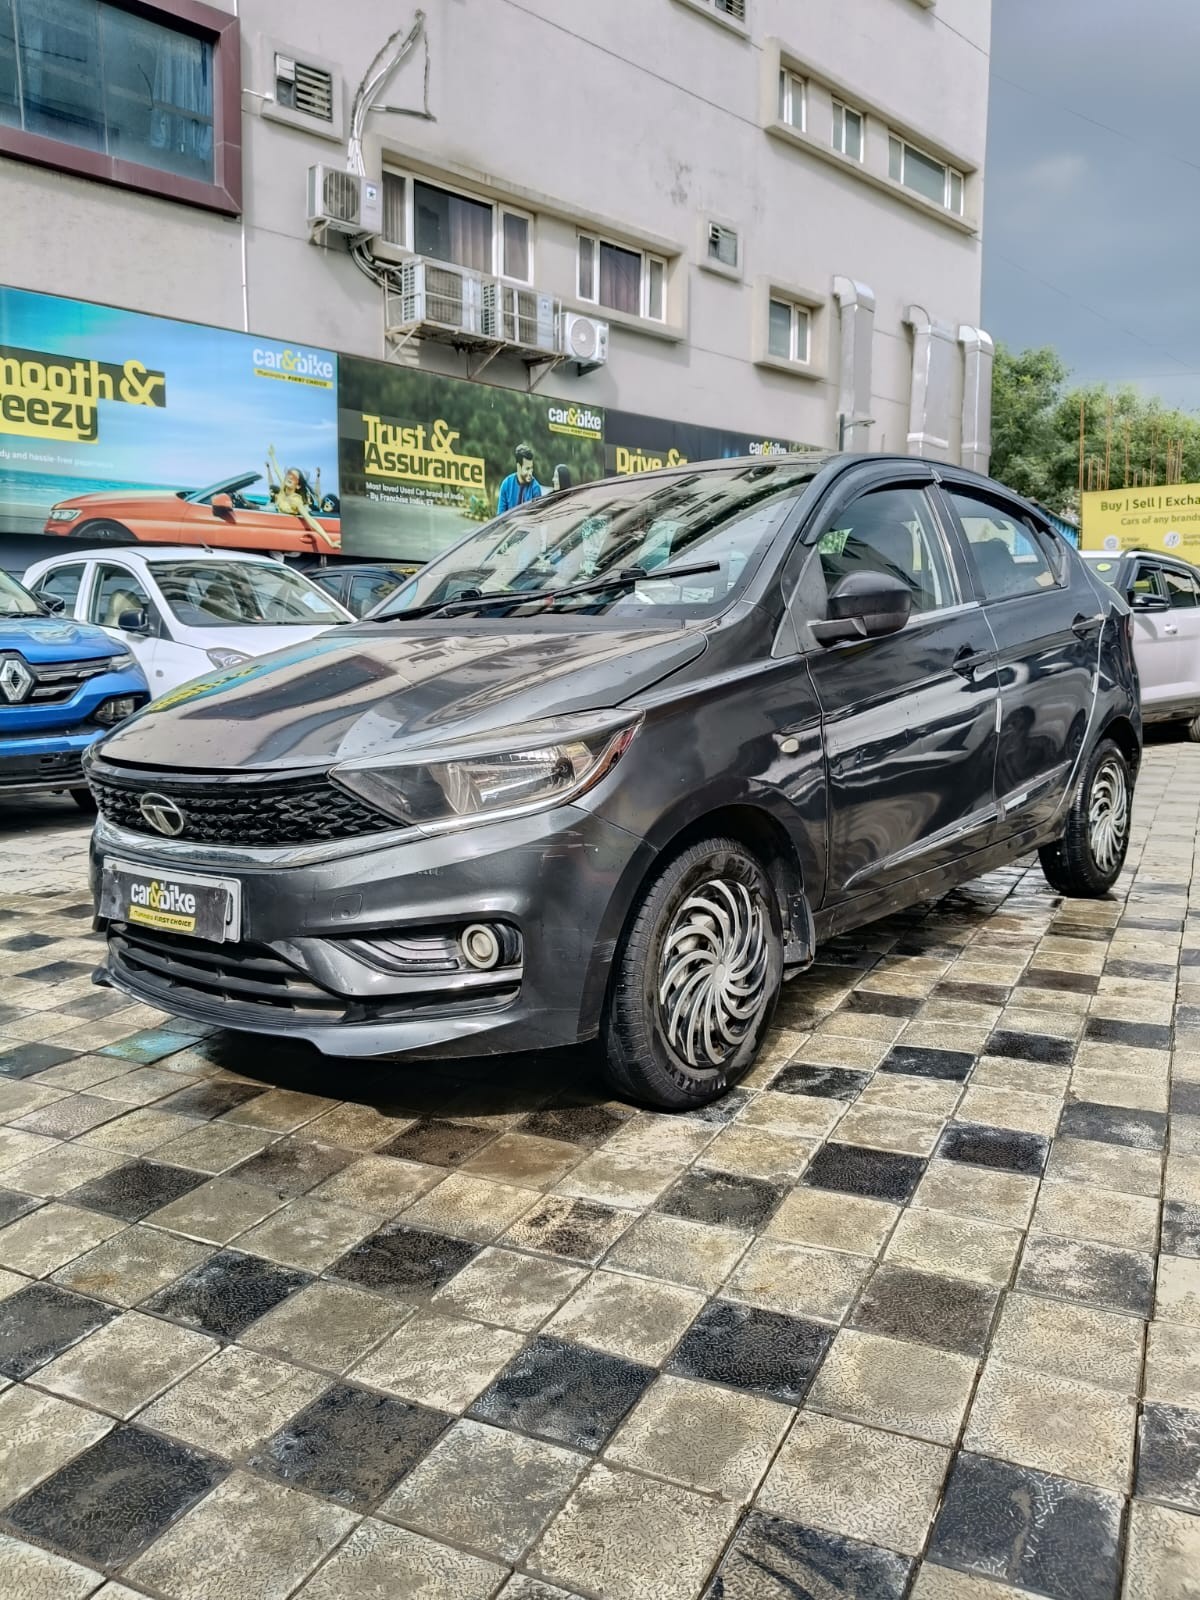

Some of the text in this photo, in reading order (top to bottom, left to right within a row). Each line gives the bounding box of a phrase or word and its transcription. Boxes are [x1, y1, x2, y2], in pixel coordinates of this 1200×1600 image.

[253, 349, 333, 378] car&bike
[119, 359, 165, 407] &
[0, 393, 98, 441] eezy
[548, 407, 602, 430] car&bike
[362, 414, 460, 456] Trust &
[365, 442, 483, 483] Assurance
[366, 481, 381, 490] Most
[382, 483, 399, 493] loved
[400, 486, 415, 495] Used
[415, 488, 426, 496] Car
[370, 492, 379, 502] By
[1100, 501, 1122, 512] Buy
[1132, 497, 1155, 509] Sell
[1166, 494, 1200, 507] Excha
[1120, 517, 1140, 526] Cars
[1141, 515, 1151, 524] of
[1153, 516, 1169, 525] any
[131, 881, 196, 914] car&bike
[154, 915, 170, 924] FIRST
[170, 918, 193, 928] CHOICE
